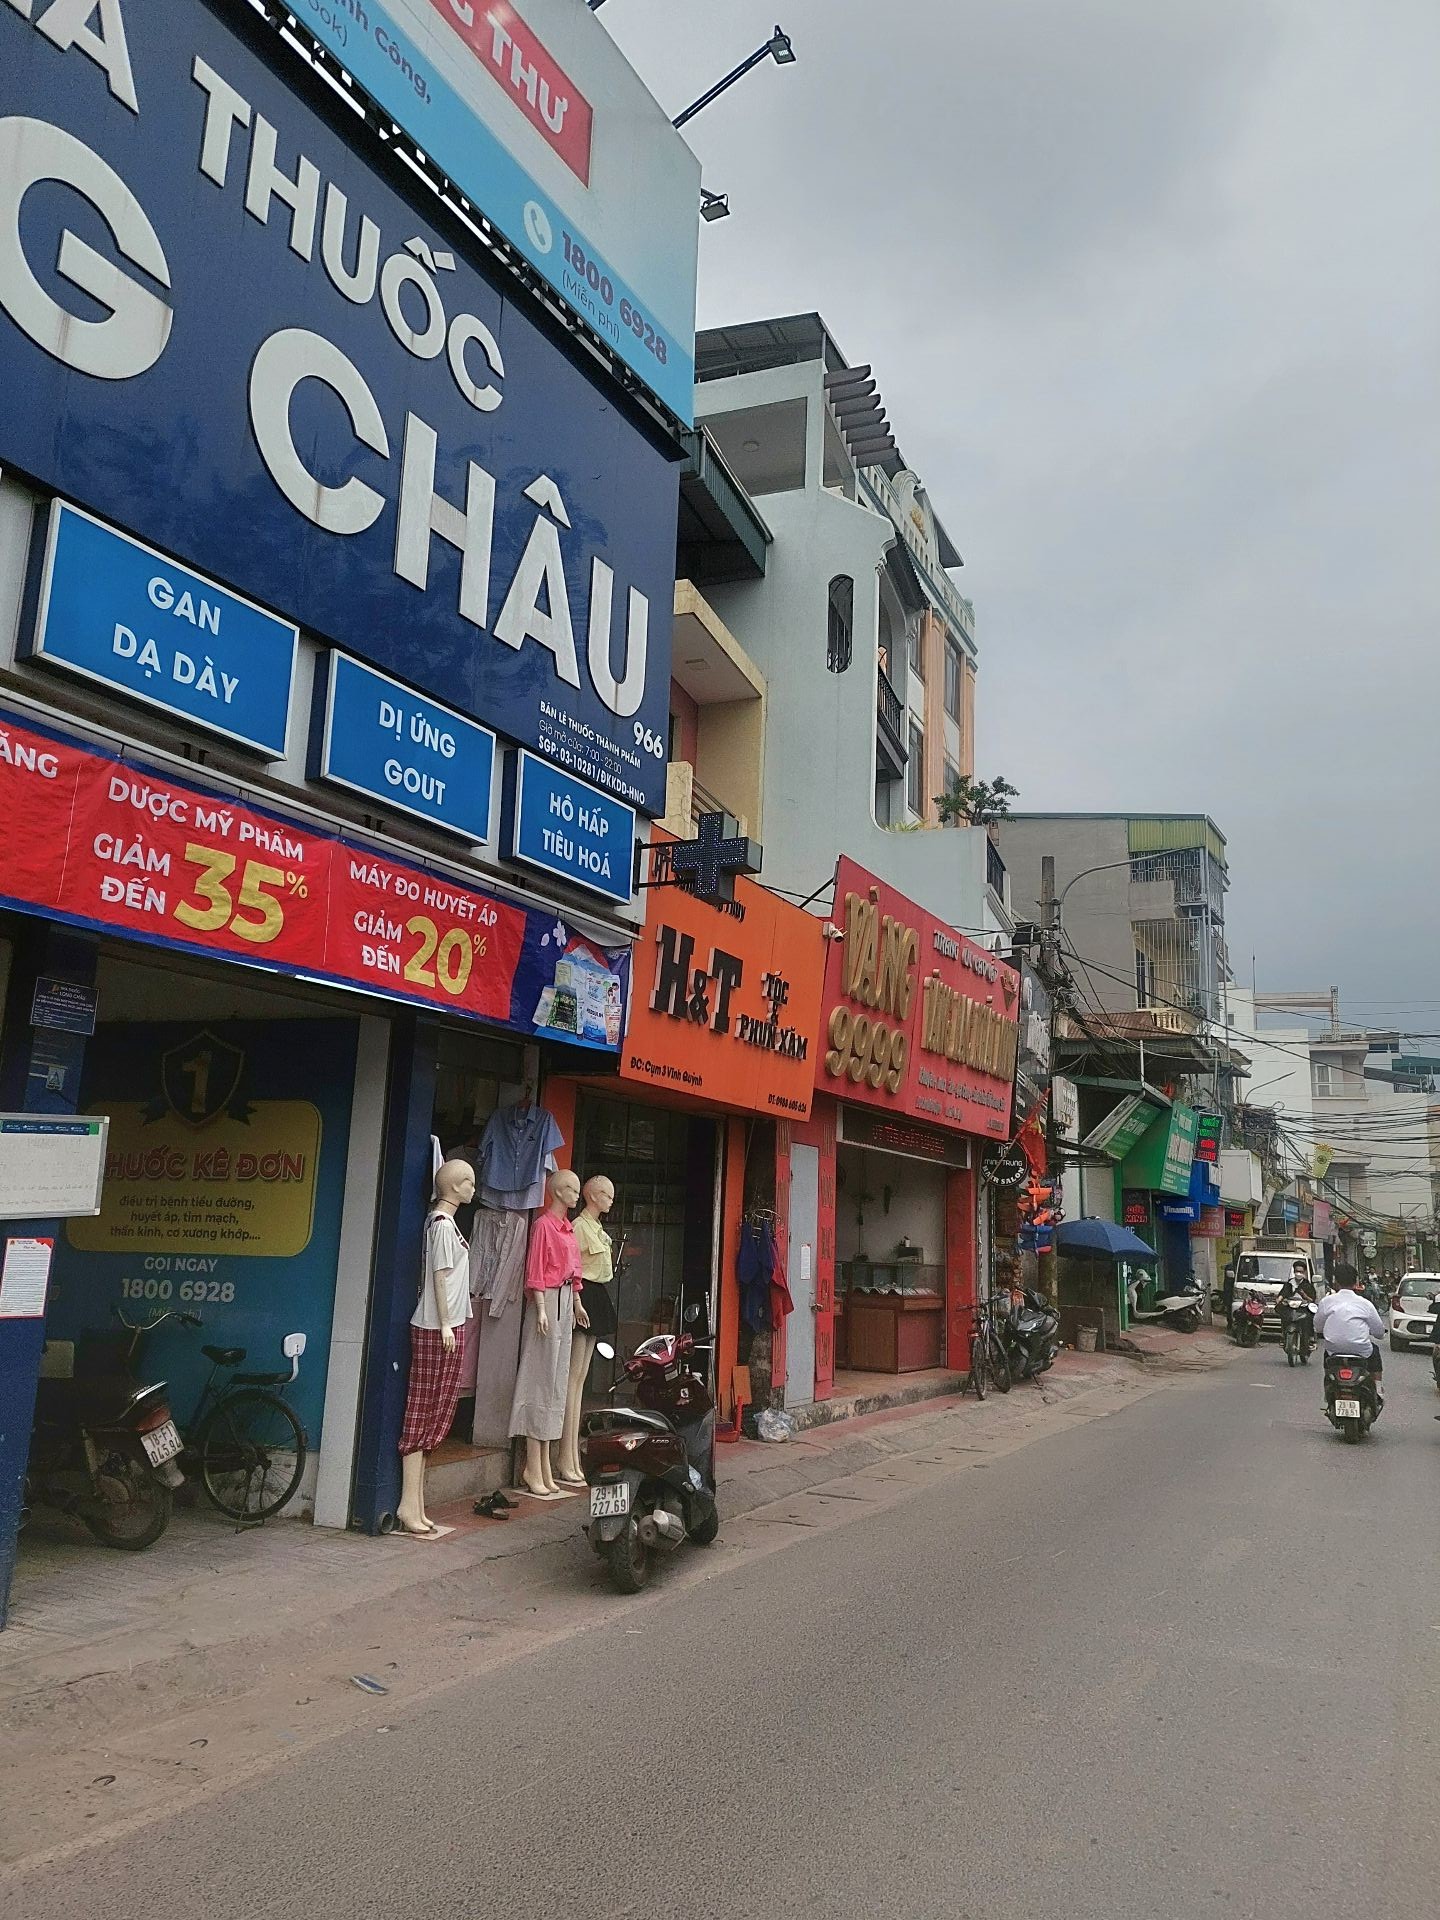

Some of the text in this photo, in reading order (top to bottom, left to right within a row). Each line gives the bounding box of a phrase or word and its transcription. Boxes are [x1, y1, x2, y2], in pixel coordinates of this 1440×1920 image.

[486, 10, 567, 134] THƯ
[191, 55, 502, 411] THUỐC
[562, 230, 667, 365] 1800 6928
[562, 269, 620, 343] (Miễn phí)
[249, 328, 648, 717] CHÂU
[147, 576, 221, 636] GAN
[112, 622, 240, 704] DẠ DÀY
[379, 700, 456, 758] DỊ ỨNG
[538, 735, 559, 758] SGP:
[568, 717, 595, 741] THUỐC
[596, 733, 620, 757] THÀNH
[620, 750, 641, 769] PHẨM
[633, 721, 664, 759] 966
[384, 758, 446, 805] GOUT
[108, 776, 304, 862] DƯỢC MỸ PHẨM
[549, 792, 610, 838] HÔ HẤP
[93, 833, 171, 877] GIẢM
[542, 828, 611, 879] TIÊU HOÁ
[99, 876, 166, 915] ĐẾN
[350, 860, 498, 927] MÁY ĐO HUYẾT ÁP
[353, 910, 403, 944] GIẢM
[361, 945, 400, 975] ĐẾN
[649, 924, 744, 1034] H&T
[761, 970, 790, 1005] TÓC
[775, 1026, 808, 1060] XĂM
[826, 1005, 907, 1095] 9999
[645, 1060, 661, 1078] Cụm
[661, 1065, 667, 1077] 3
[667, 1066, 682, 1082] Vĩnh
[104, 1145, 186, 1180] HUỐC
[191, 1147, 231, 1180] KÊ
[235, 1150, 305, 1181] ĐƠN
[1000, 1166, 1025, 1185] SALON
[1163, 1205, 1195, 1217] Vinamilk
[144, 1256, 218, 1274] GỌI NGAY
[122, 1278, 235, 1303] 1800 6928
[148, 1424, 173, 1448] 18-F1
[591, 1498, 627, 1516] 227.69
